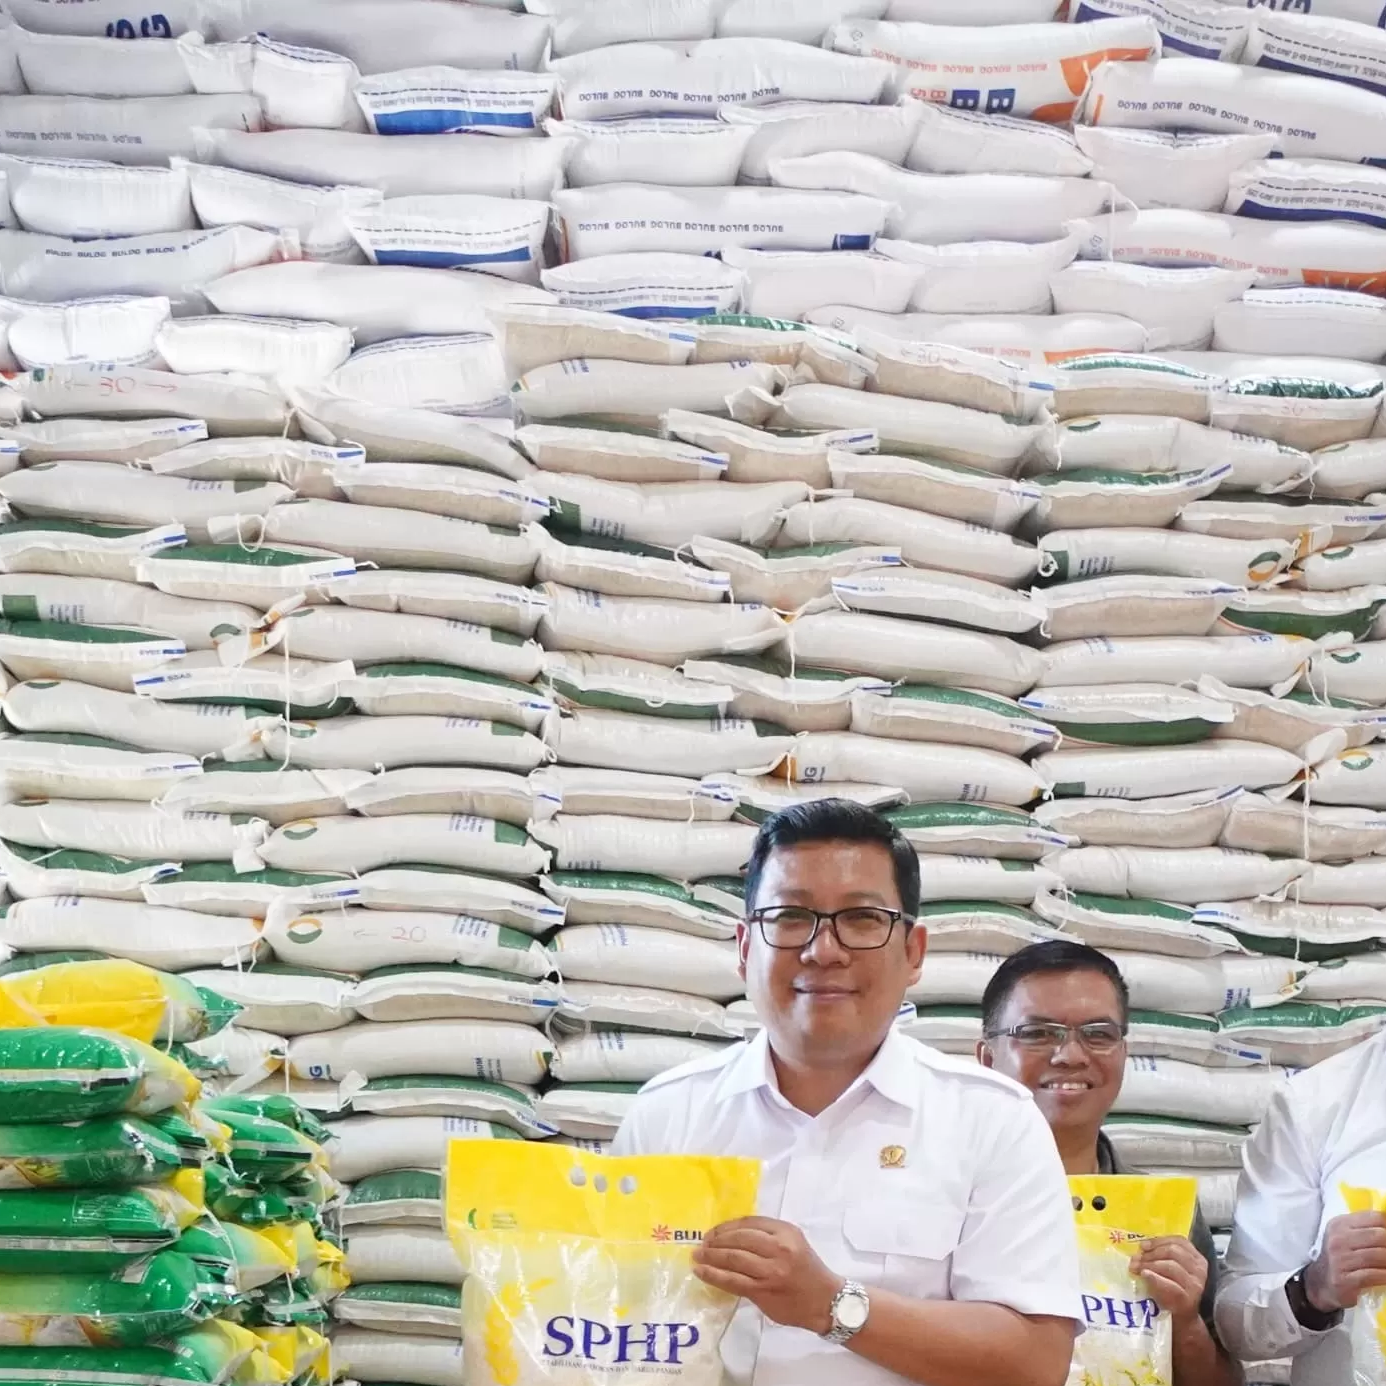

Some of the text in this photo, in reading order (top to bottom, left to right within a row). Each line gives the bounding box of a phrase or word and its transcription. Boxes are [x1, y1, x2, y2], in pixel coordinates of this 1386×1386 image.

[579, 87, 780, 102] BULOG BULOG BULOG BULOG BULOG BULOG
[1118, 99, 1316, 140] BULOG BULOG BULOG BULOG BULOG BULOG
[579, 221, 783, 232] BULOG BULOG BULOG BULOG BULOG BULOG
[391, 926, 427, 943] 20
[674, 1230, 704, 1241] BUL
[1081, 1294, 1160, 1330] PHP
[542, 1315, 700, 1364] SPHP
